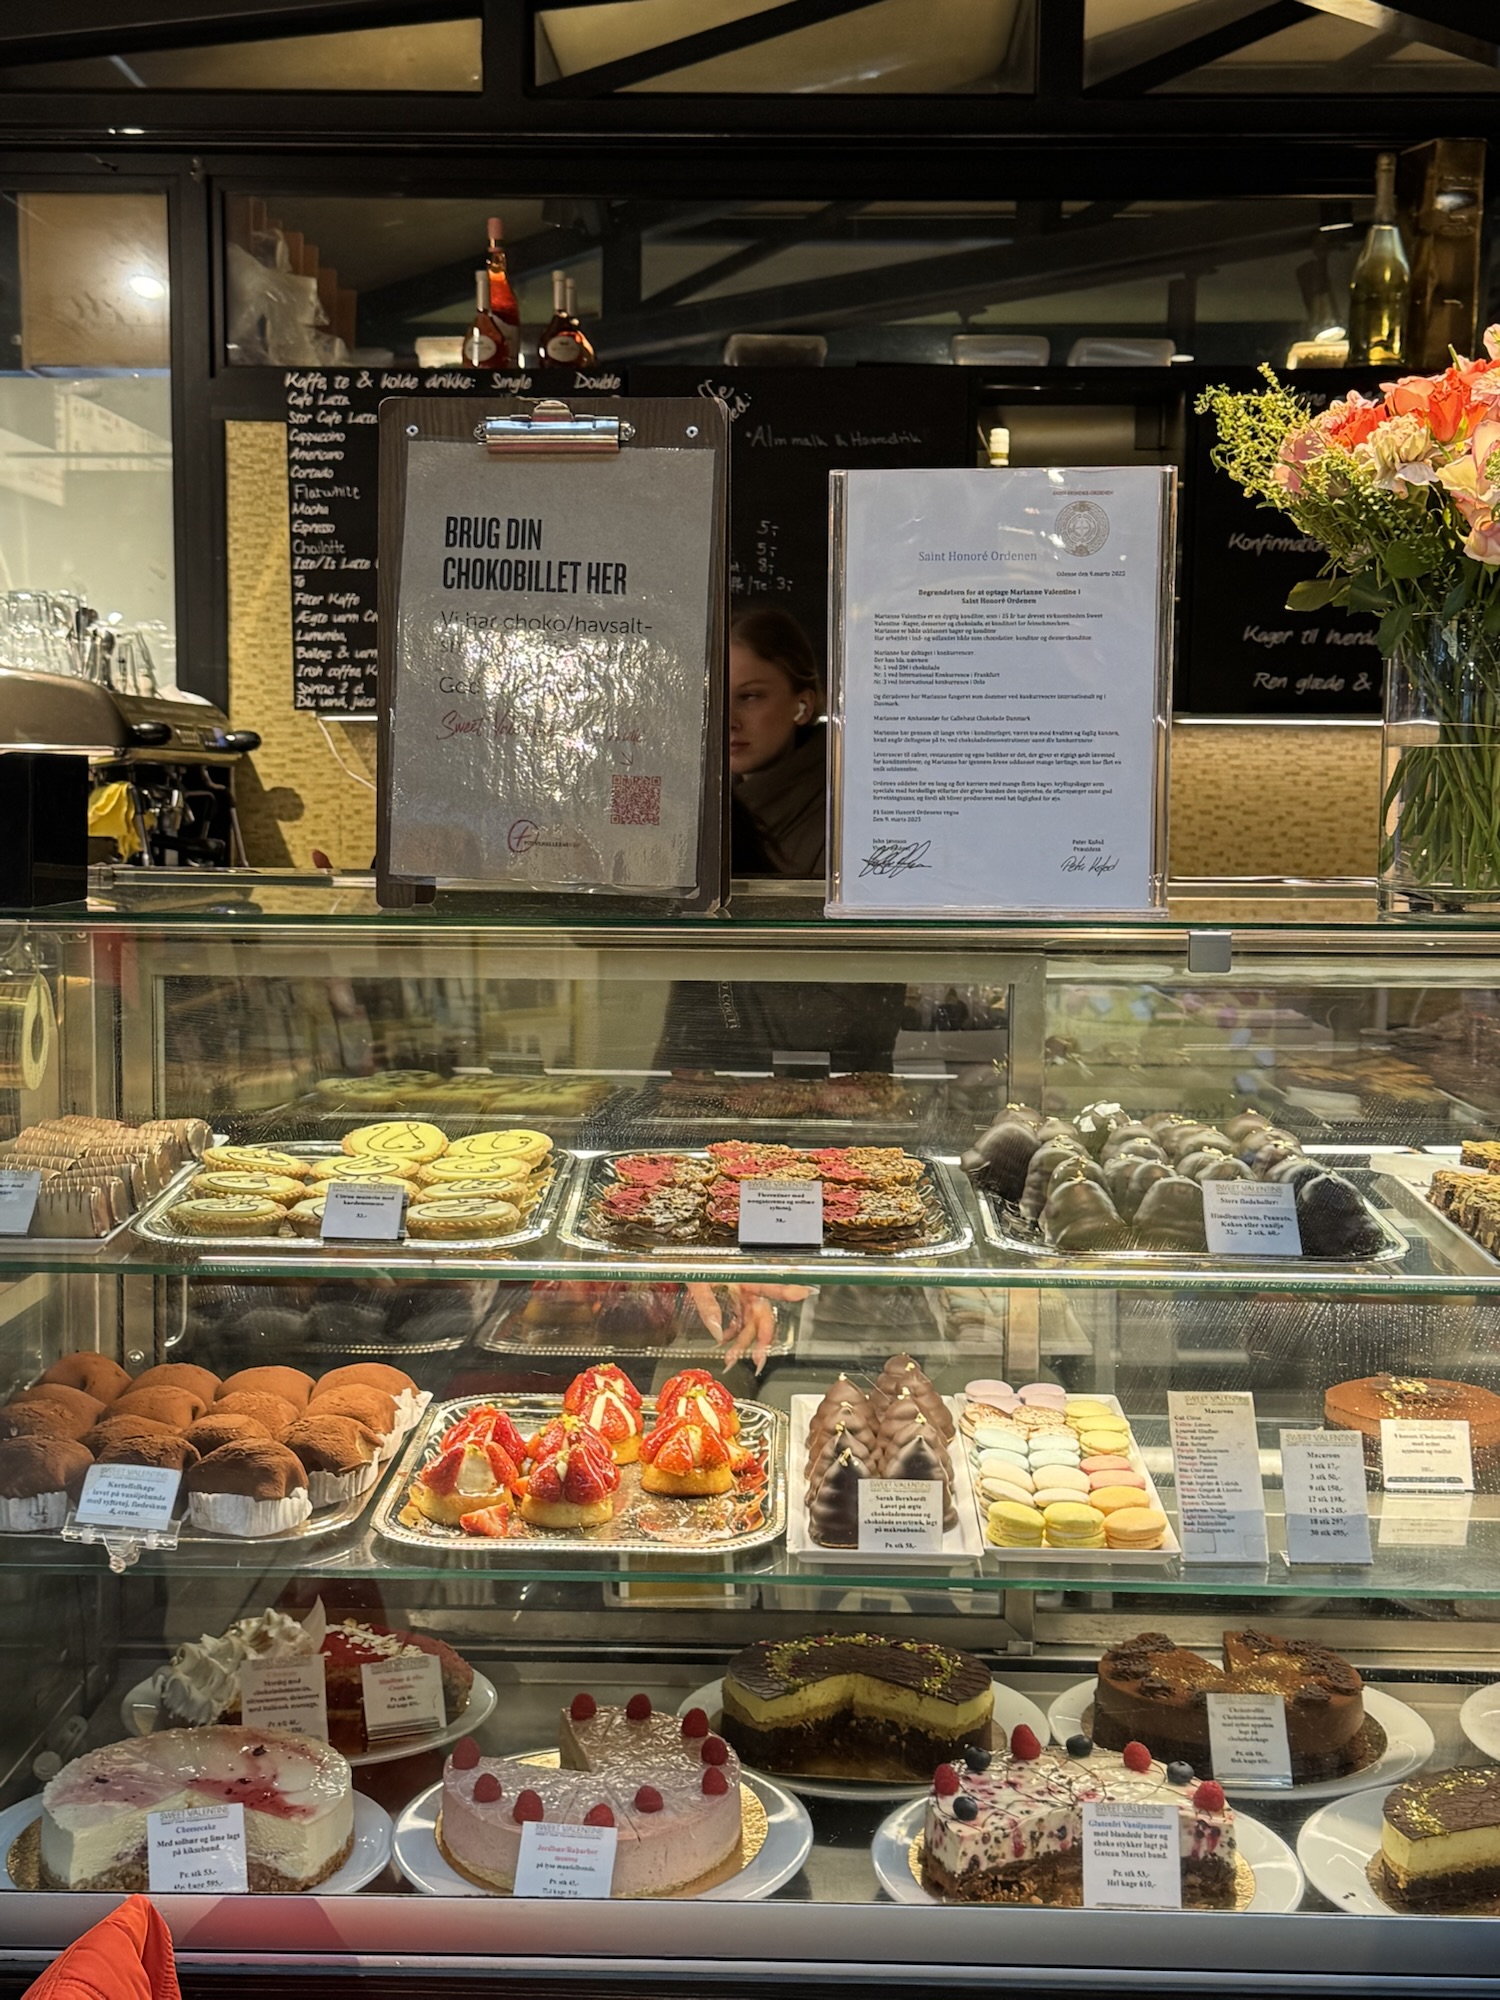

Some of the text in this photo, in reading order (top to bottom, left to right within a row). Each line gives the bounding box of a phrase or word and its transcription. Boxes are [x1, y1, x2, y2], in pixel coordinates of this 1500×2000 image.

[334, 375, 350, 389] te
[356, 370, 374, 388] &
[381, 372, 419, 389] kolde
[574, 372, 621, 389] Double
[288, 410, 313, 424] Stor
[290, 447, 345, 460] Americano
[290, 464, 334, 479] Cortado
[292, 502, 329, 516] Mocha
[444, 515, 542, 551] BRUG DIN
[919, 550, 1037, 561] Saint Honoré Ordenen
[442, 557, 627, 596] CHOKOBILLET HER
[986, 590, 1008, 598] optage
[1010, 588, 1042, 596] Marianne
[1044, 588, 1077, 596] Valentine
[1243, 625, 1293, 648] Kager
[1302, 629, 1319, 644] til
[336, 645, 350, 659] &
[1353, 672, 1372, 691] &
[1286, 1434, 1359, 1442] SWEET VALENTINE
[160, 1807, 229, 1820] SWEET VALENTINE
[1123, 1805, 1165, 1816] VALENTINE
[176, 1823, 216, 1834] Cheesecake
[175, 1837, 198, 1845] solbær
[1117, 1841, 1142, 1849] stykker
[1144, 1842, 1158, 1850] lagt
[1159, 1844, 1168, 1852] på
[172, 1849, 181, 1858] på
[1094, 1849, 1168, 1859] Gateau Marcel bund.
[1121, 1880, 1137, 1888] kage
